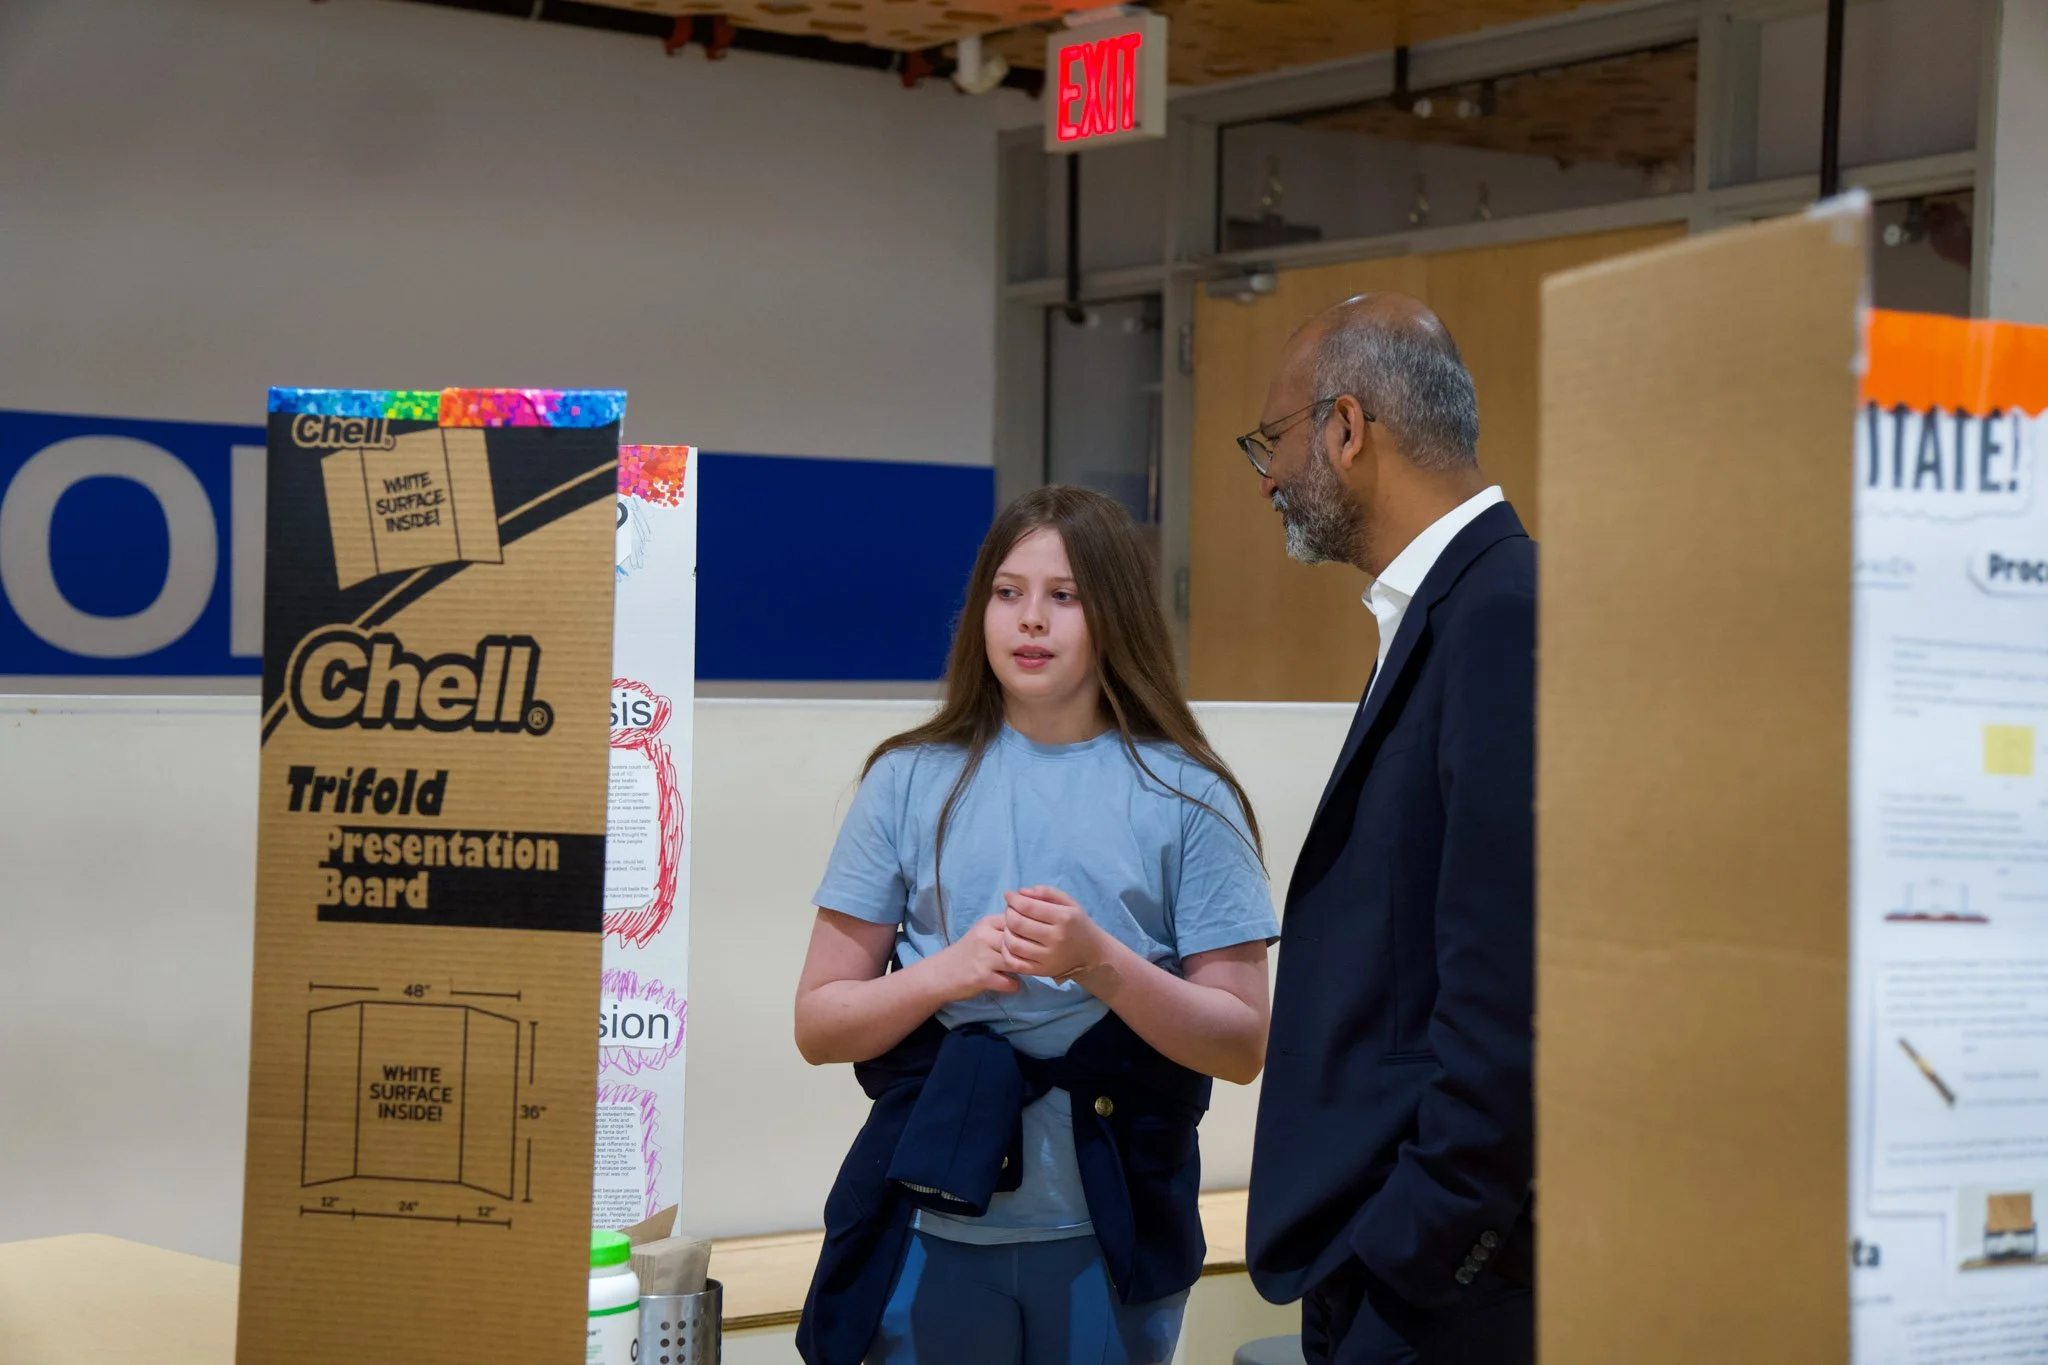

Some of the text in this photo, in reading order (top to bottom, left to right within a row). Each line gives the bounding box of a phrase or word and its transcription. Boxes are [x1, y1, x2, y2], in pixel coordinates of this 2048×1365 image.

[1057, 31, 1142, 142] EXIT
[382, 471, 432, 493] WHITE
[376, 488, 446, 515] SURFACE
[385, 508, 440, 532] INSIDE!
[288, 765, 448, 816] Trifold
[327, 826, 559, 871] Presentation
[325, 868, 429, 909] Board
[383, 1065, 441, 1083] WHITE
[370, 1083, 453, 1103] SURFACE
[378, 1103, 443, 1122] INSIDE!
